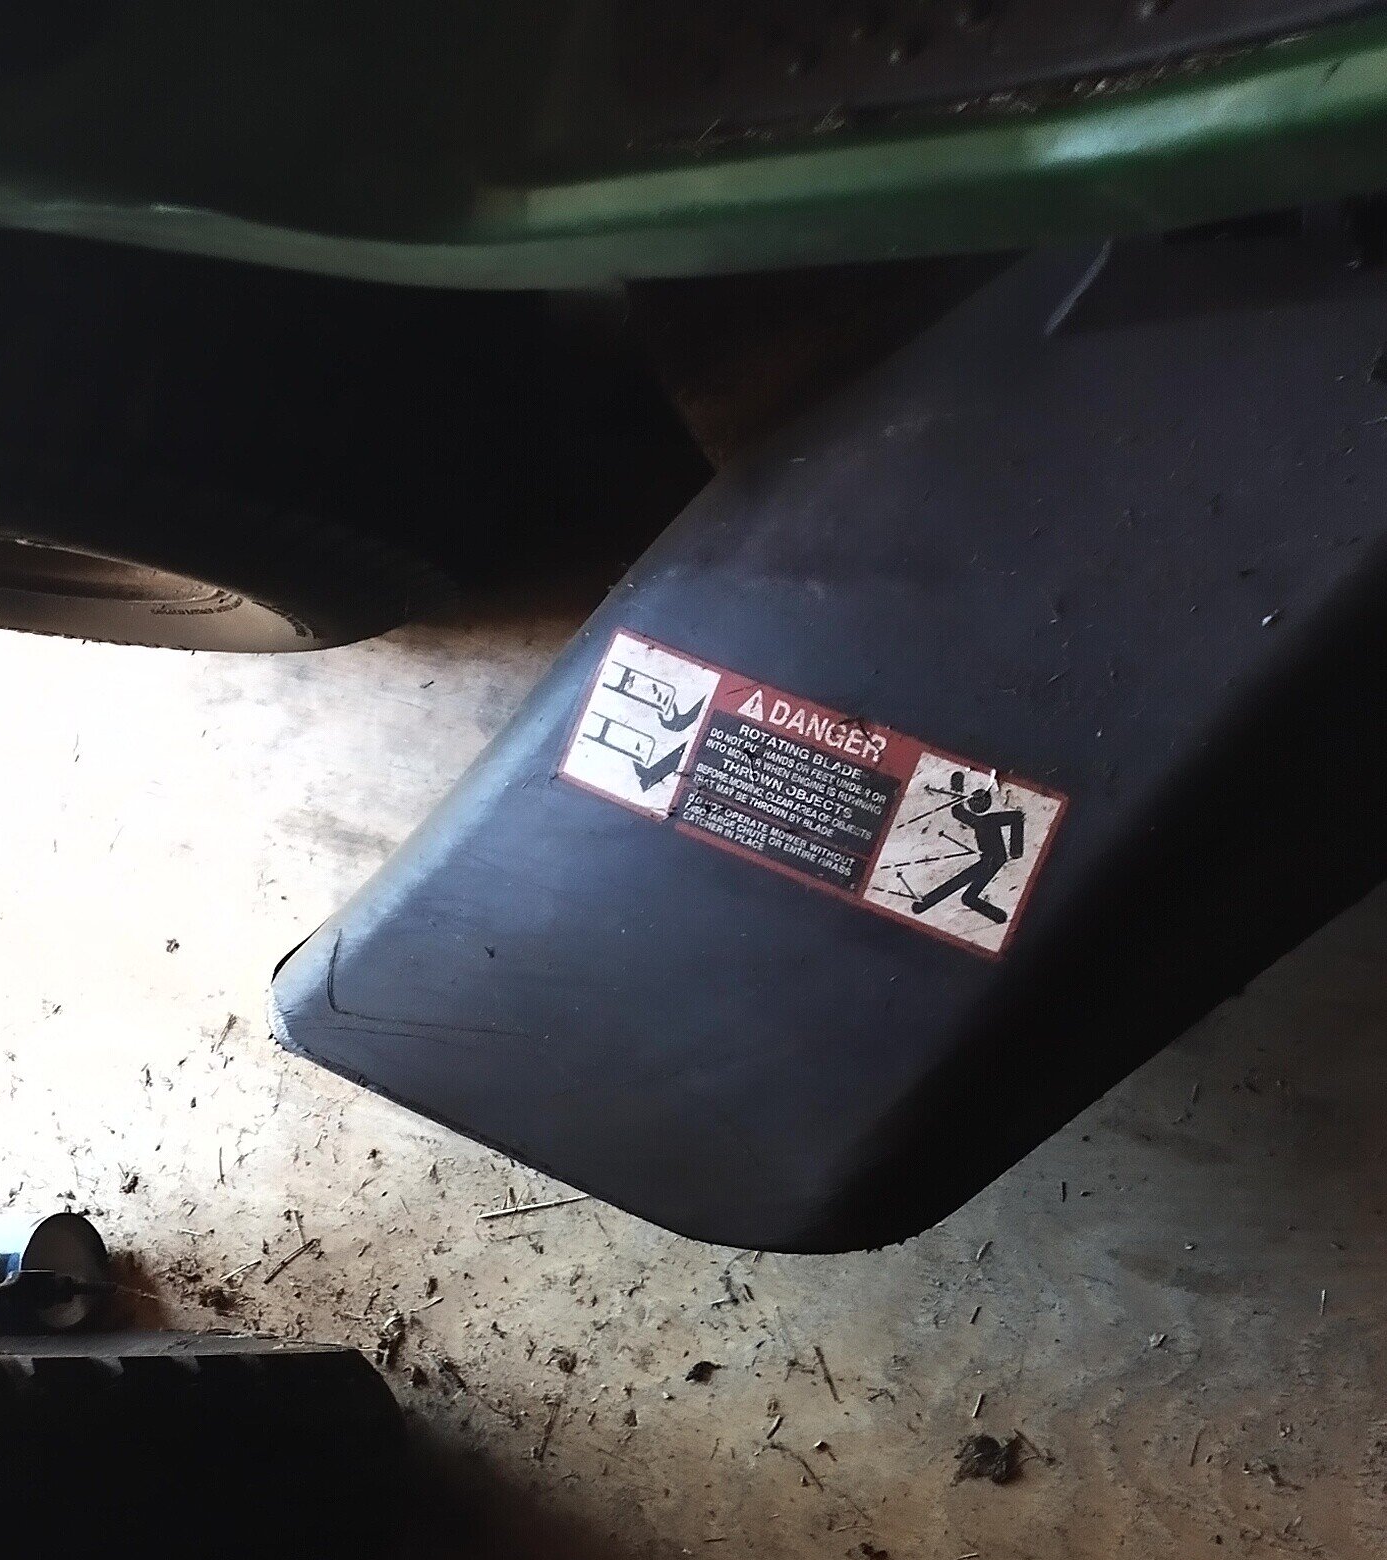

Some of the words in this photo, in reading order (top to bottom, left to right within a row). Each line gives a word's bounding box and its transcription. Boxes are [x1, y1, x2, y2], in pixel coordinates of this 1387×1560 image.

[739, 724, 810, 760] ROTATING
[812, 753, 862, 780] BLADE
[769, 700, 886, 761] DANGER
[705, 738, 727, 753] INTO
[763, 761, 791, 779] WHEN
[790, 772, 826, 793] ENGINE
[825, 786, 837, 797] IS
[709, 727, 724, 740] DO
[723, 733, 745, 748] NOT
[762, 749, 795, 769] HANDS
[795, 761, 810, 774] OR
[810, 768, 836, 784] FEET
[871, 792, 887, 804] OR
[723, 758, 783, 792] THROWN
[785, 785, 852, 819] OBJECTS
[696, 762, 729, 783] BEFORE
[765, 791, 794, 810] CLEAR
[792, 803, 817, 819] AREA
[817, 812, 832, 823] OF
[831, 818, 872, 840] OBJECTS
[715, 783, 735, 797] MAY
[734, 791, 749, 803] BE
[749, 797, 789, 819] THROWN
[787, 812, 803, 824] BY
[802, 818, 834, 838] BLADE
[682, 811, 724, 834] CATCHER
[724, 828, 735, 839] IN
[734, 833, 765, 851] PLACE
[724, 808, 769, 833] OPERATE
[769, 827, 807, 849] MOWER
[809, 842, 855, 868] WITHOUT
[736, 823, 768, 842] CHUTE
[768, 836, 783, 848] OR
[783, 842, 817, 862] ENTIRE
